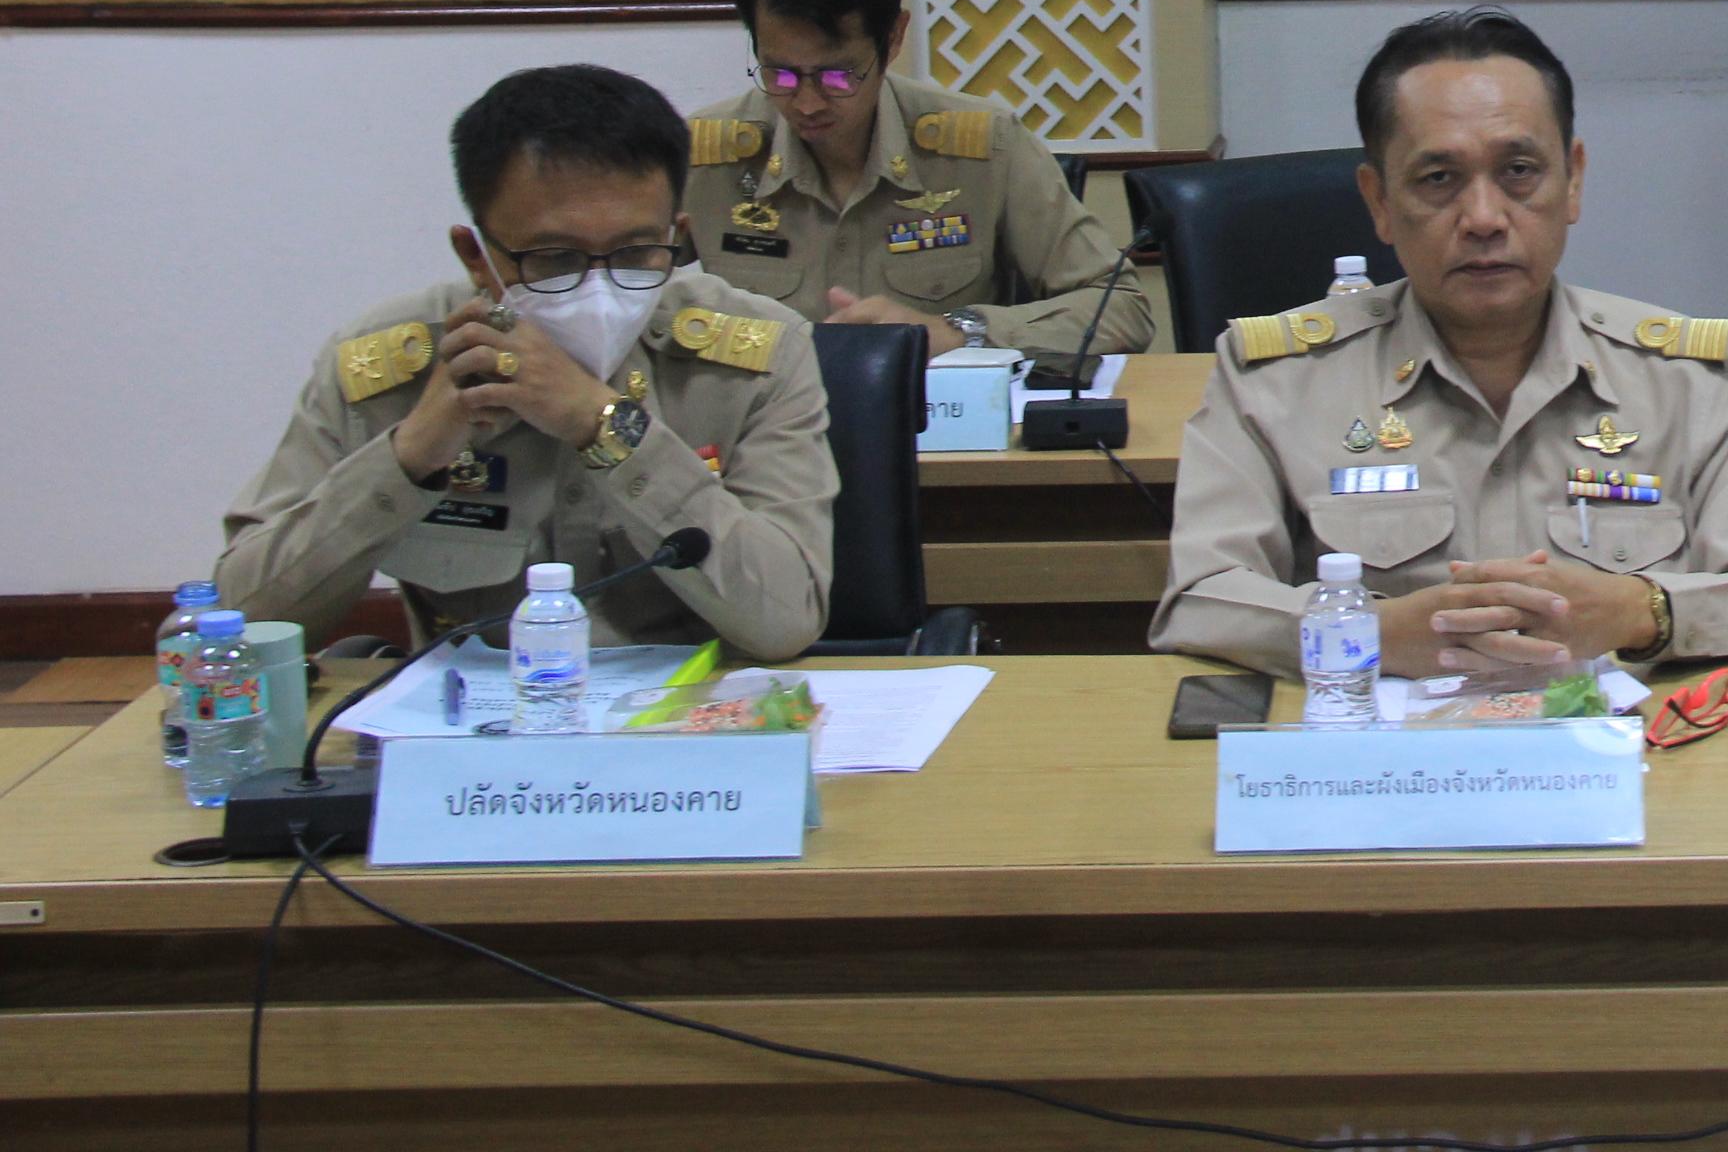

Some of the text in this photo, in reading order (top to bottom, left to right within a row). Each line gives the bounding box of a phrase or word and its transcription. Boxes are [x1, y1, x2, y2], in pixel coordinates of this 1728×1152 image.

[444, 781, 742, 816] ปลัดจังหวัดหนองคาย
[1235, 767, 1618, 798] โยธาธิการและผังเมืองจังหวัดหนองคาย
